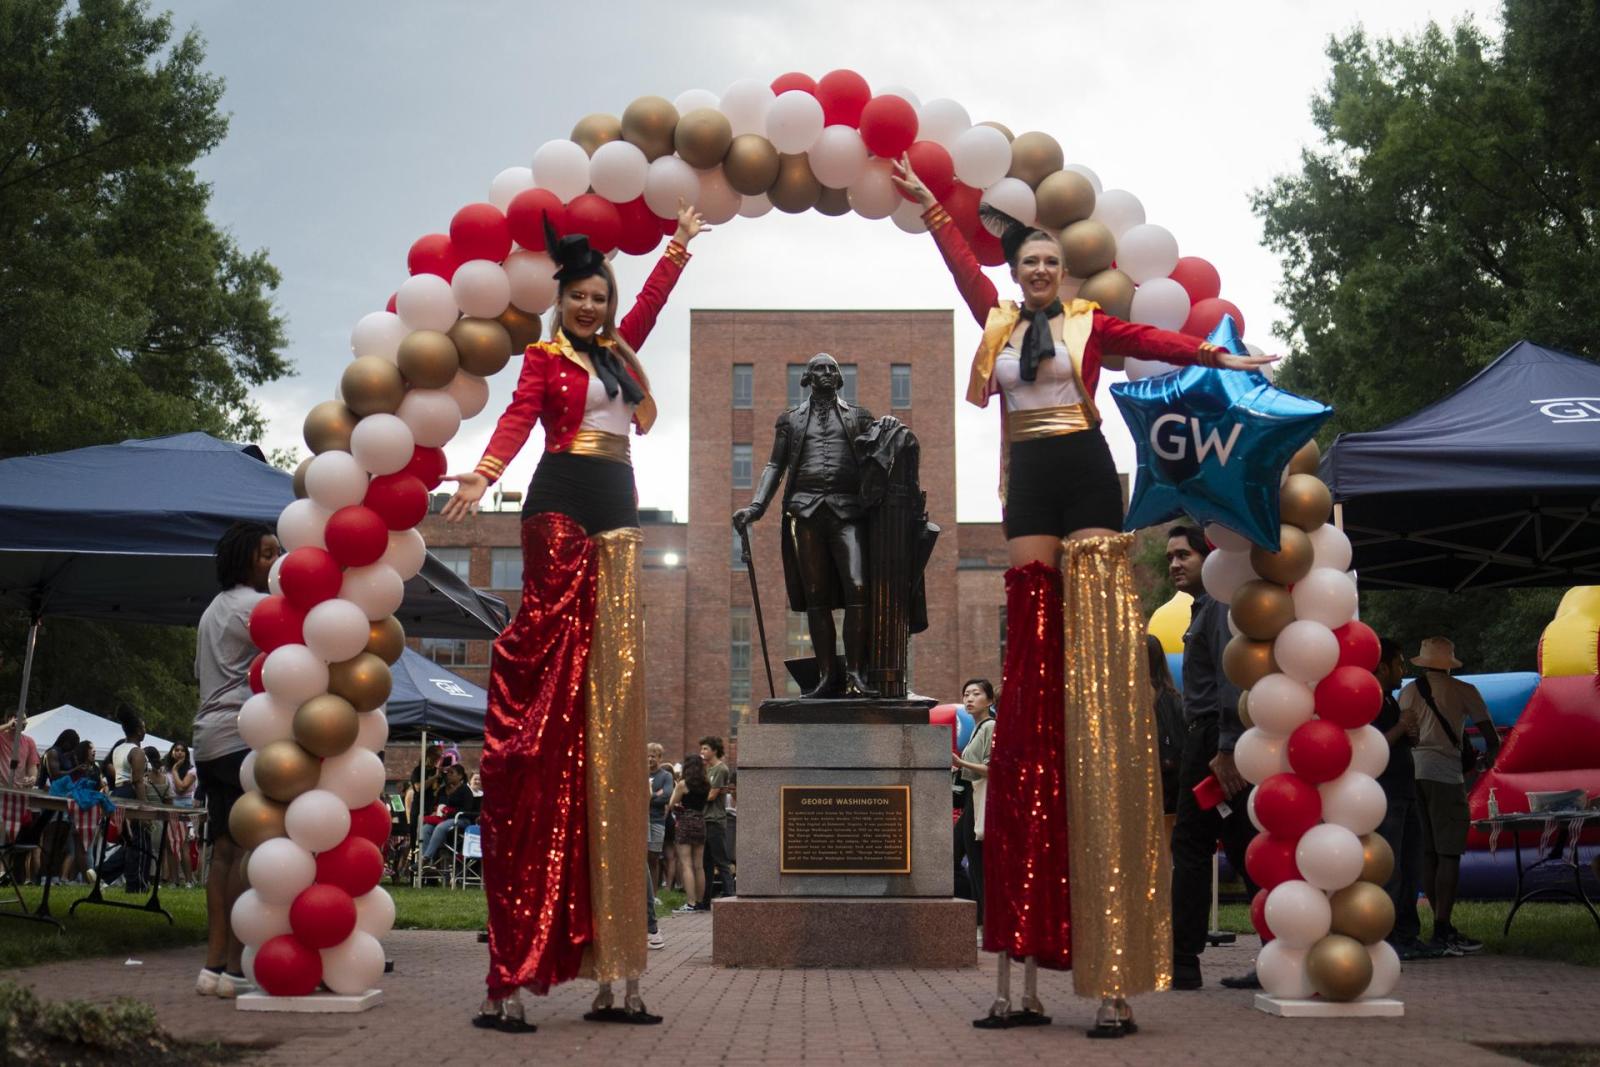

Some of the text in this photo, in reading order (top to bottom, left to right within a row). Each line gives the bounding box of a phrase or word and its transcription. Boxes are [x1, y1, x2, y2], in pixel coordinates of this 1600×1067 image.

[1150, 413, 1244, 467] GW
[801, 798, 889, 806] GEORGE WASHINGTON
